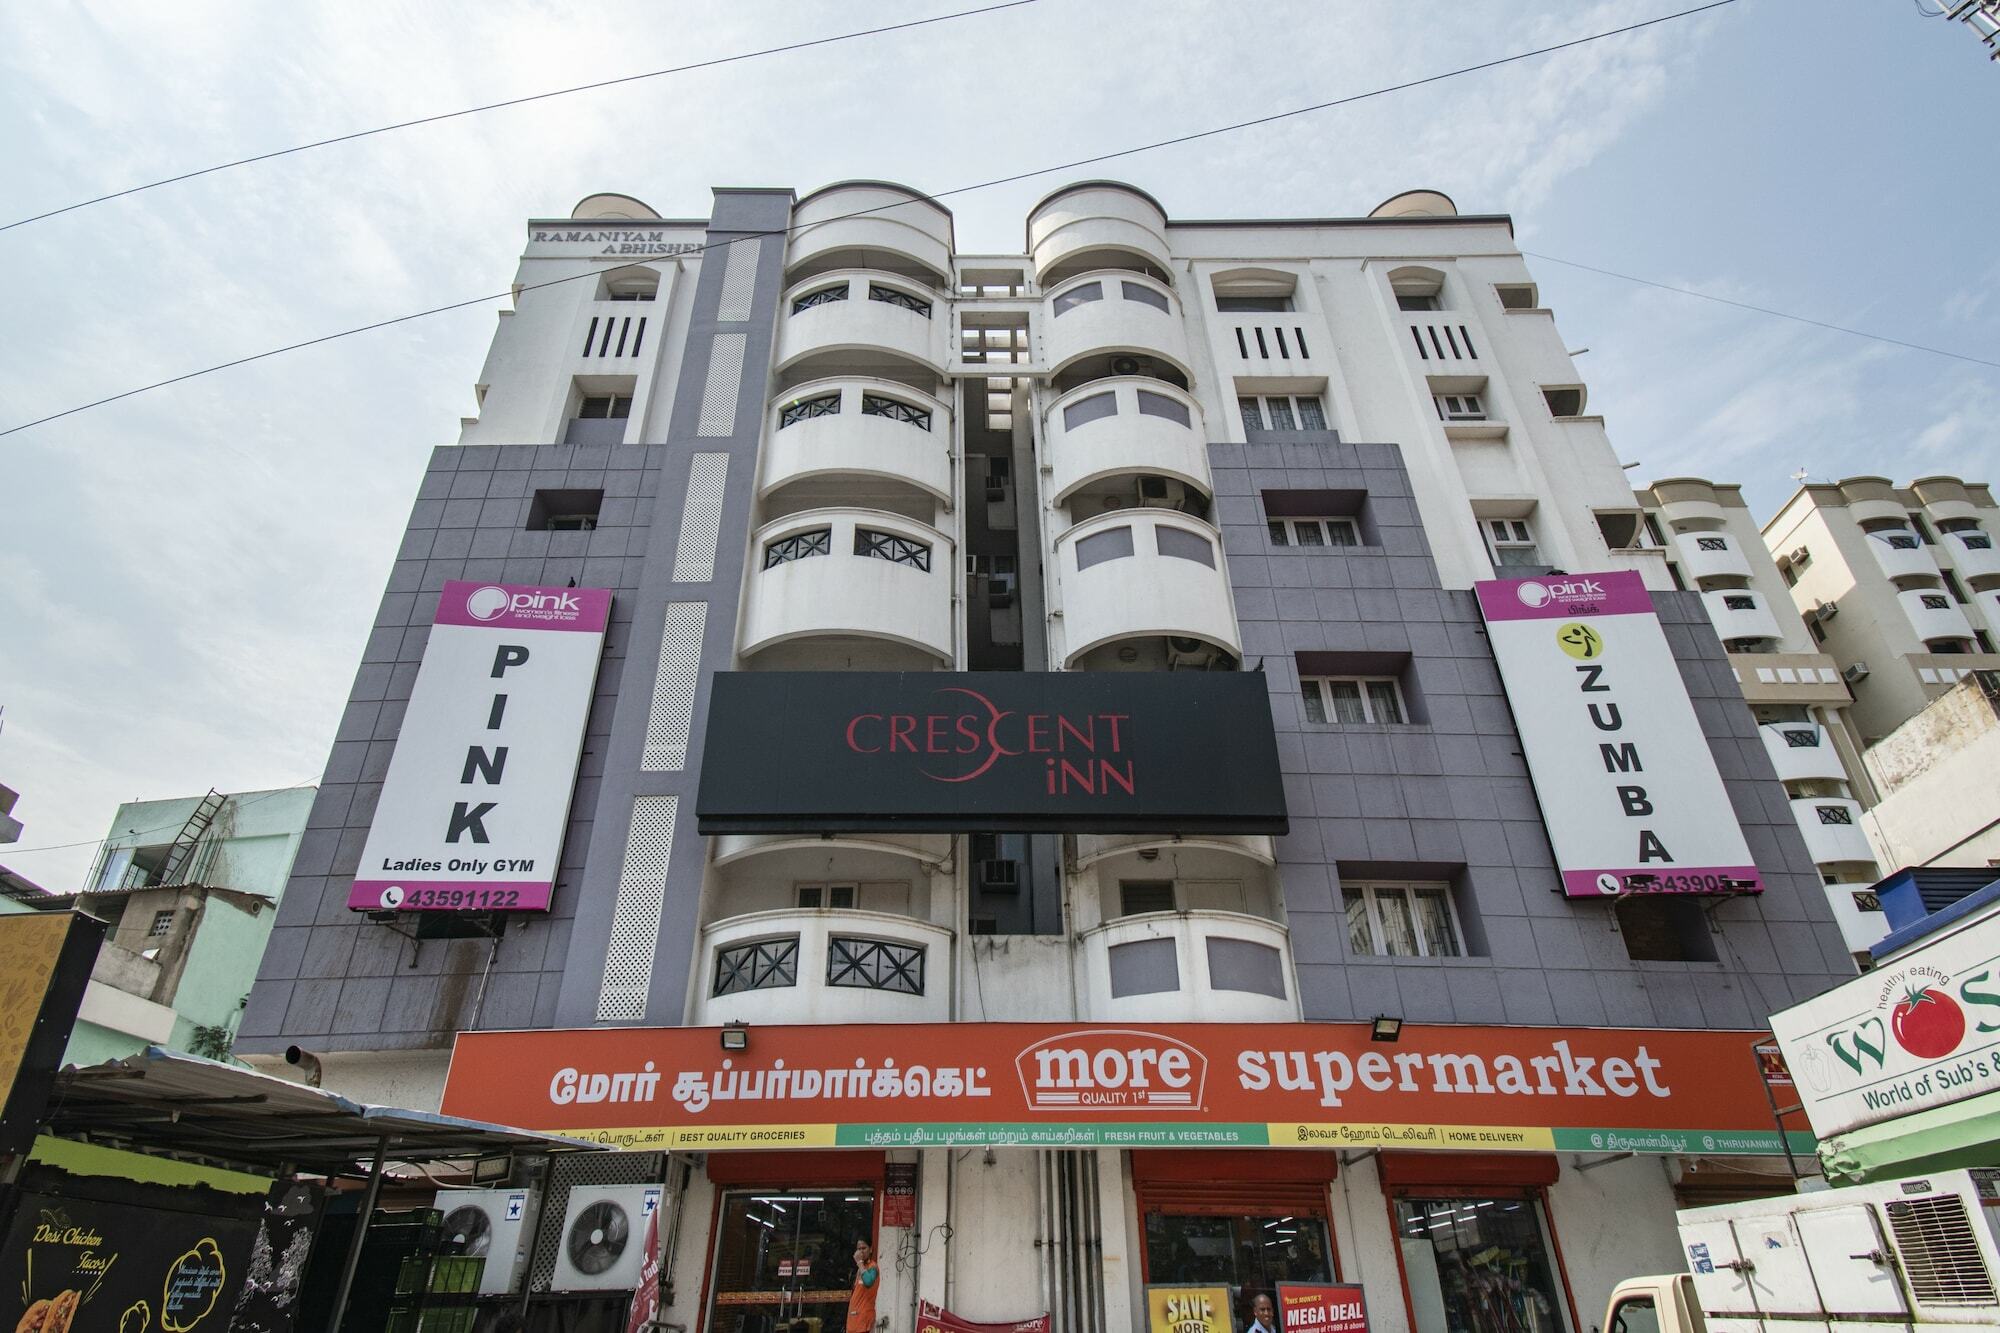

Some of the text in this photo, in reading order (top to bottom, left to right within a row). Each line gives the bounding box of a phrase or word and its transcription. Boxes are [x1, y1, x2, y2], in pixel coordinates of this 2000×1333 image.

[534, 231, 664, 242] RAMANIYAM
[1548, 579, 1605, 598] pink
[510, 591, 581, 611] pink
[846, 711, 1129, 755] CRESCENT
[445, 644, 530, 844] PINK
[1576, 665, 1675, 863] ZUMBA
[382, 858, 534, 875] Ladies Only GYM
[407, 890, 519, 906] 43591122
[1877, 966, 1950, 1010] healthy eating
[1035, 1048, 1192, 1089] more
[1237, 1039, 1671, 1107] supermarket
[550, 1057, 991, 1113] மோர் சூப்பர்மார்க்கெட்
[1863, 1081, 1913, 1110] World
[1916, 1074, 1933, 1096] of
[1935, 1060, 1989, 1089] Sub's
[1082, 1090, 1145, 1104] QUALITY 1st
[680, 1131, 805, 1142] BEST QUALITY GROCERIES
[1105, 1132, 1239, 1142] FRESH FRUIT & VEGETABLES
[1297, 1125, 1338, 1141] இலவச
[1449, 1132, 1523, 1142] HOME DELIVERY
[1591, 1133, 1602, 1148] @
[1703, 1136, 1791, 1150] @ THIRUVANMIYU
[33, 1224, 102, 1246] Desi Chicken
[76, 1250, 106, 1270] Tacos
[1167, 1294, 1213, 1324] SAVE
[1287, 1302, 1363, 1326] MEGA DEAL
[1173, 1322, 1209, 1333] MORE
